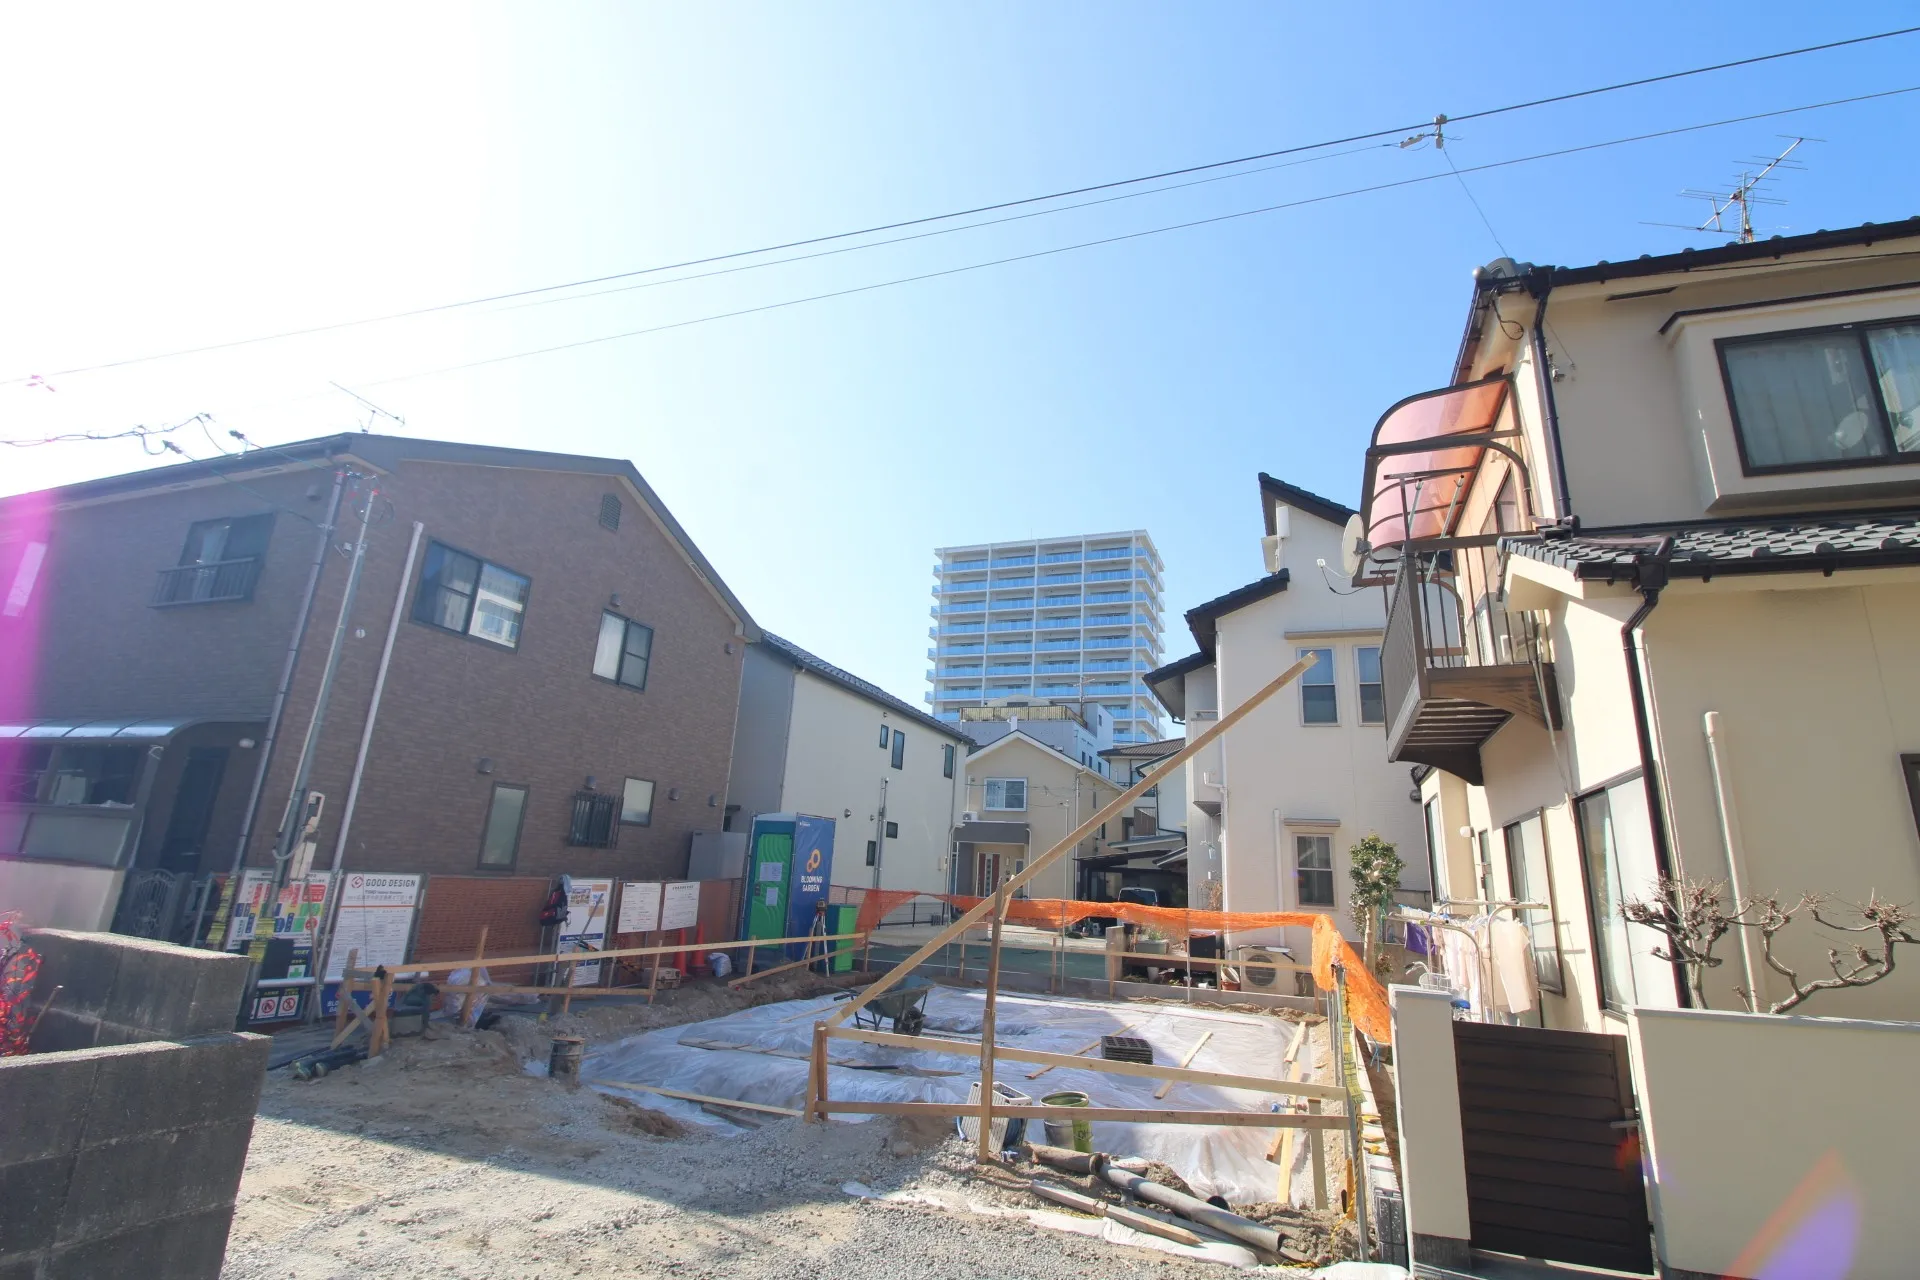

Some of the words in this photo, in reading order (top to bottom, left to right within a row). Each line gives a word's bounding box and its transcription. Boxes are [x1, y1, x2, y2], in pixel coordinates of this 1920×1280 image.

[365, 878, 387, 887] GOOD
[388, 879, 416, 887] DESIGN
[801, 875, 823, 883] BLOOMING
[802, 884, 820, 892] GARDEN
